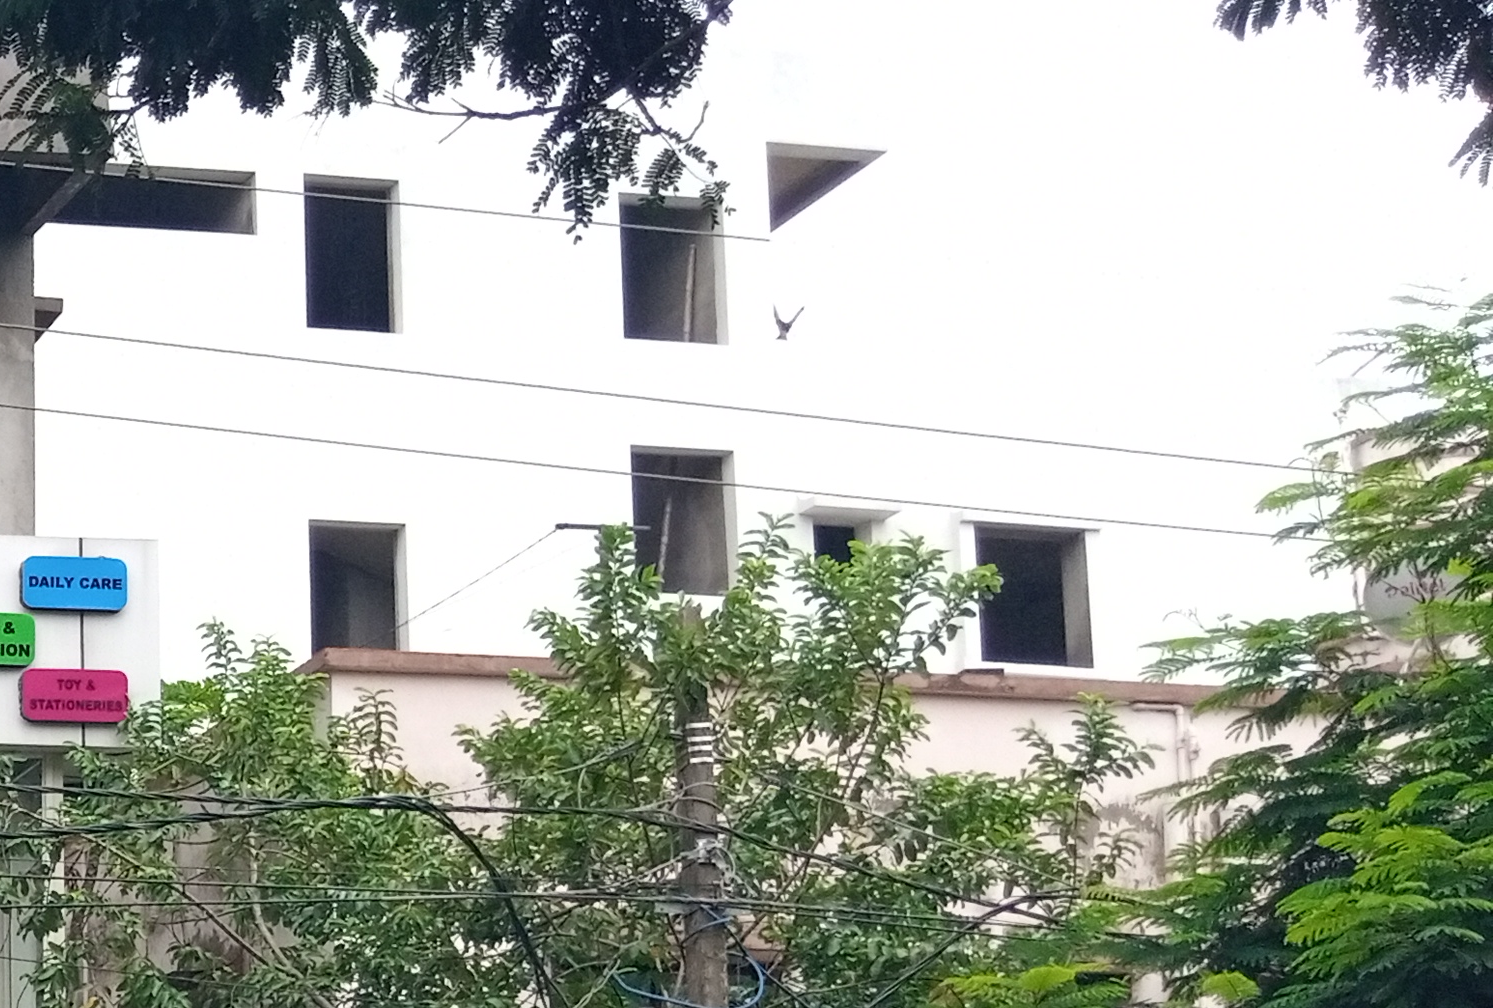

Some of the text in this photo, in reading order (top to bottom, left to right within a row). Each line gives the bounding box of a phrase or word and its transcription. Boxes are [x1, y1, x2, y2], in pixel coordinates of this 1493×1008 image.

[28, 576, 123, 590] DAILY CARE
[3, 621, 15, 634] &
[57, 679, 96, 691] TOY &
[29, 699, 123, 712] STATIONERIES
